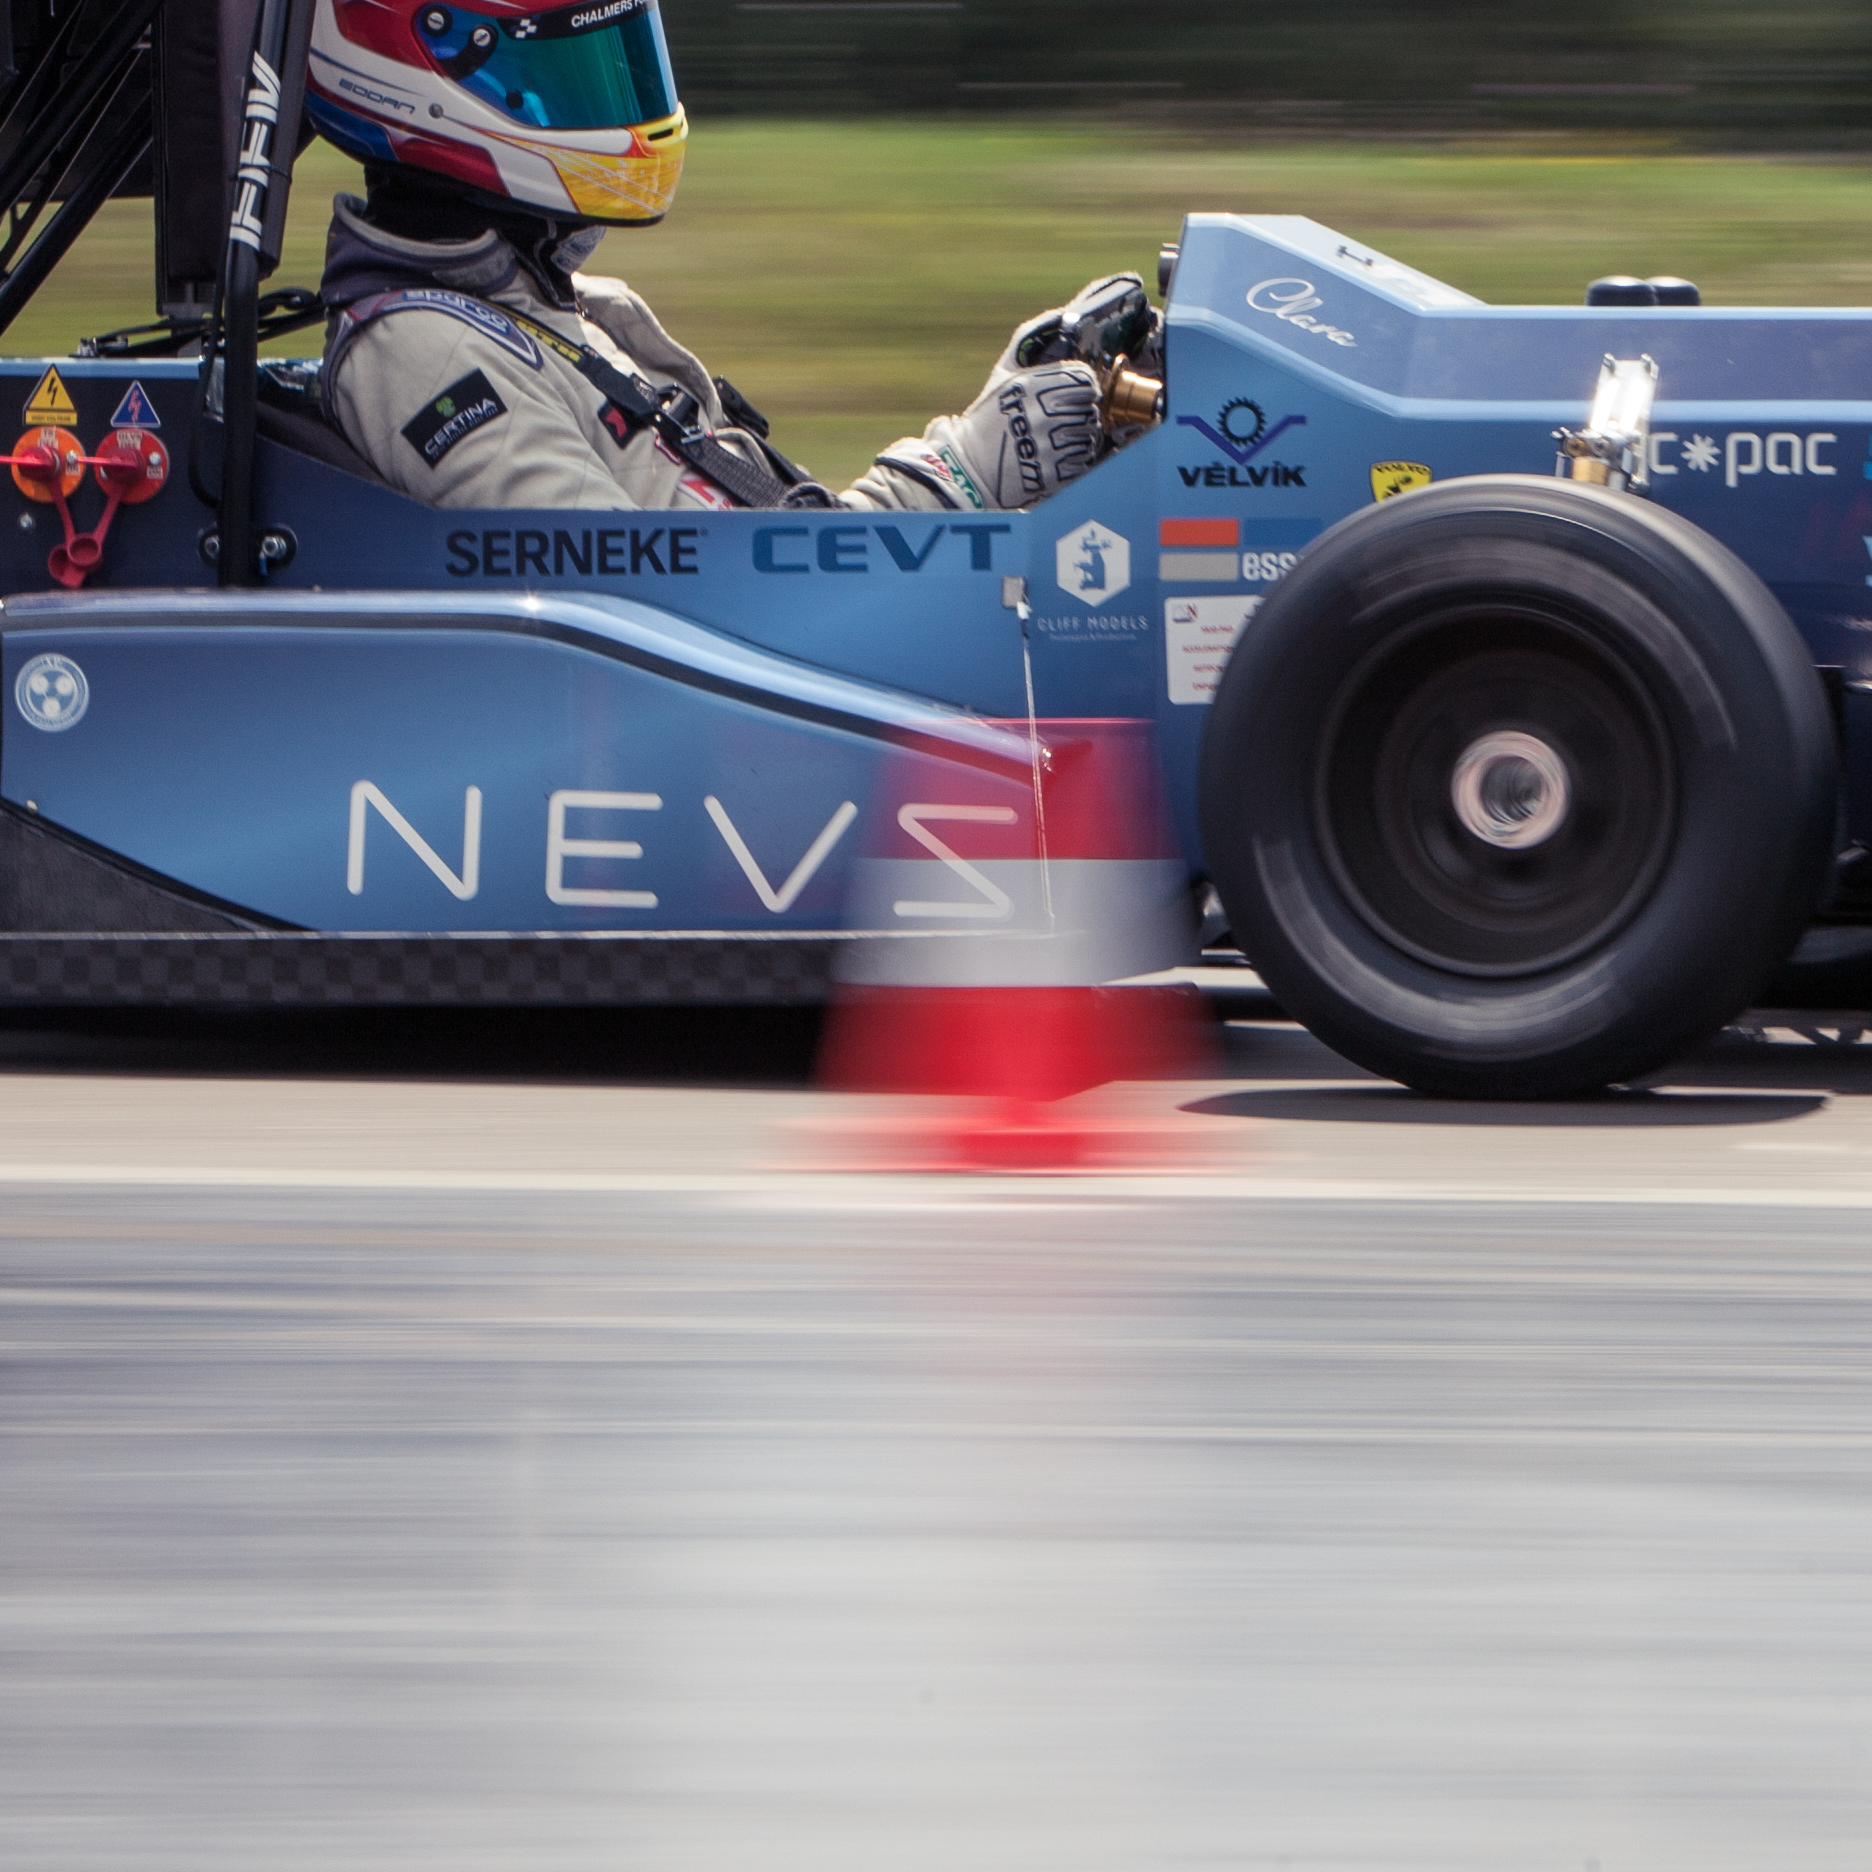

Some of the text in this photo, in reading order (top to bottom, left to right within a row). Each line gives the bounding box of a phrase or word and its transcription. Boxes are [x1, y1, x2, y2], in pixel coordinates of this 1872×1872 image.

[1246, 277, 1359, 347] Clara
[424, 397, 499, 456] CERTINA
[445, 528, 699, 576] SERNEKE
[751, 524, 1011, 574] CEVT
[346, 779, 1019, 918] NEVS
